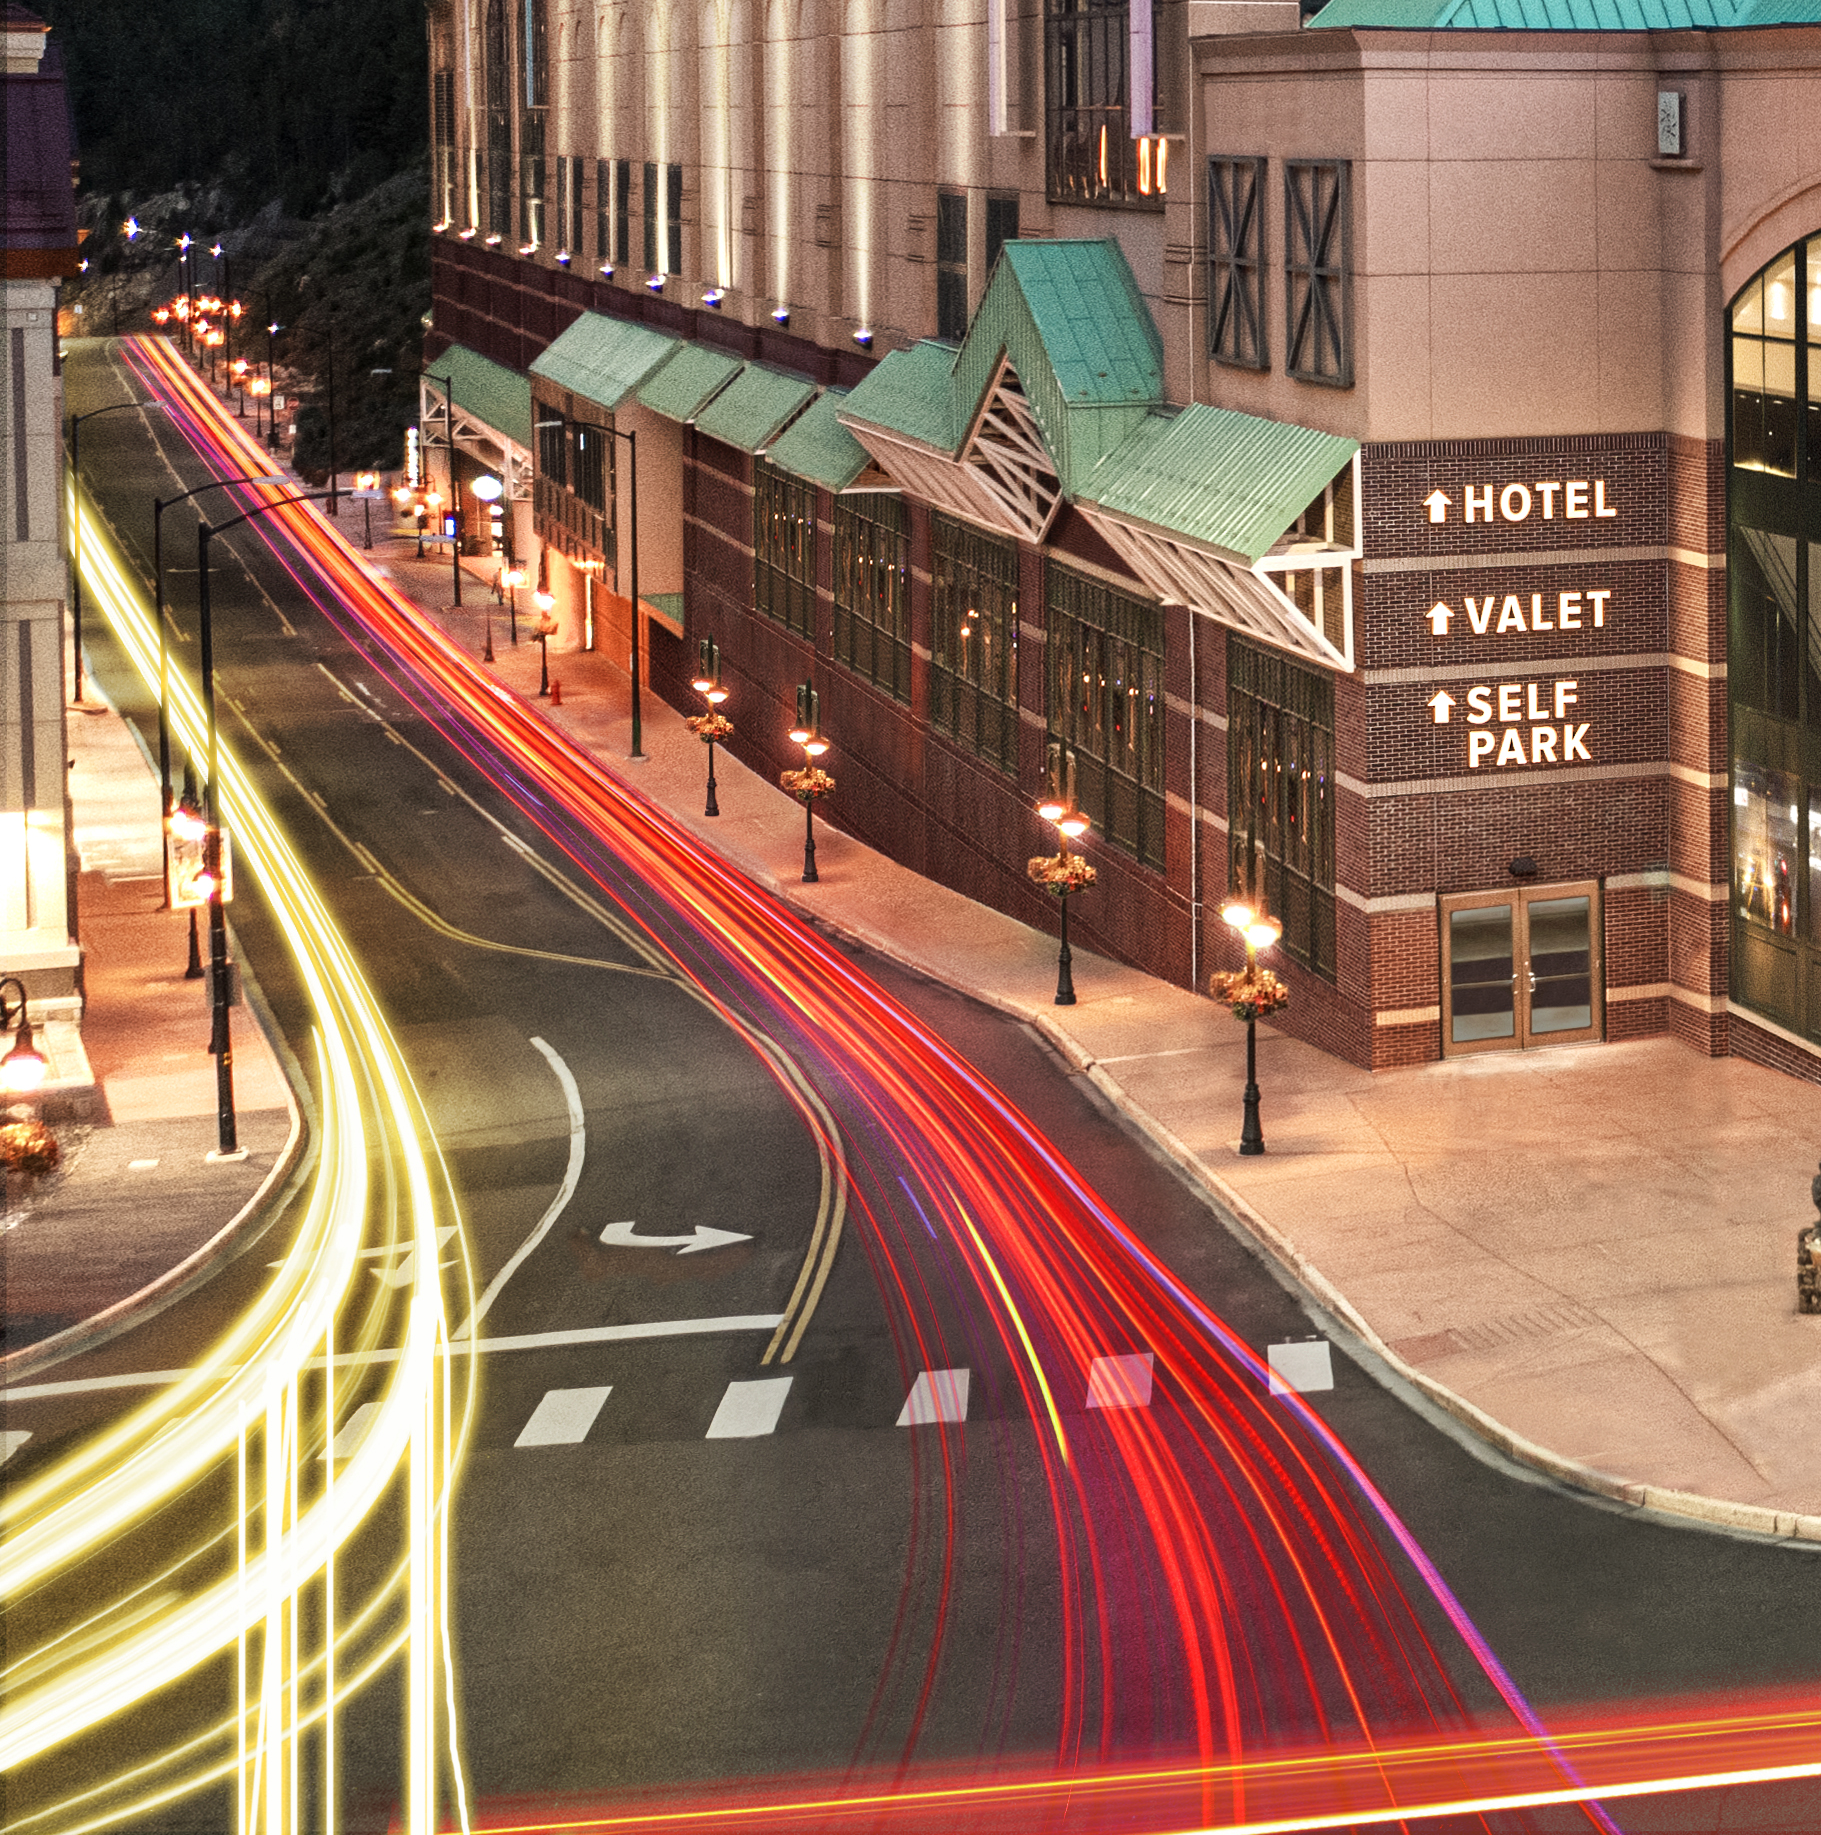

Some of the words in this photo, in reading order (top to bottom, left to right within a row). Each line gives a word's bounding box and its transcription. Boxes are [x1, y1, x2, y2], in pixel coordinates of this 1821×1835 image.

[1464, 480, 1618, 524] HOTEL
[1464, 590, 1612, 635] VALET
[1466, 681, 1579, 725] SELF
[1468, 722, 1593, 768] PARK
